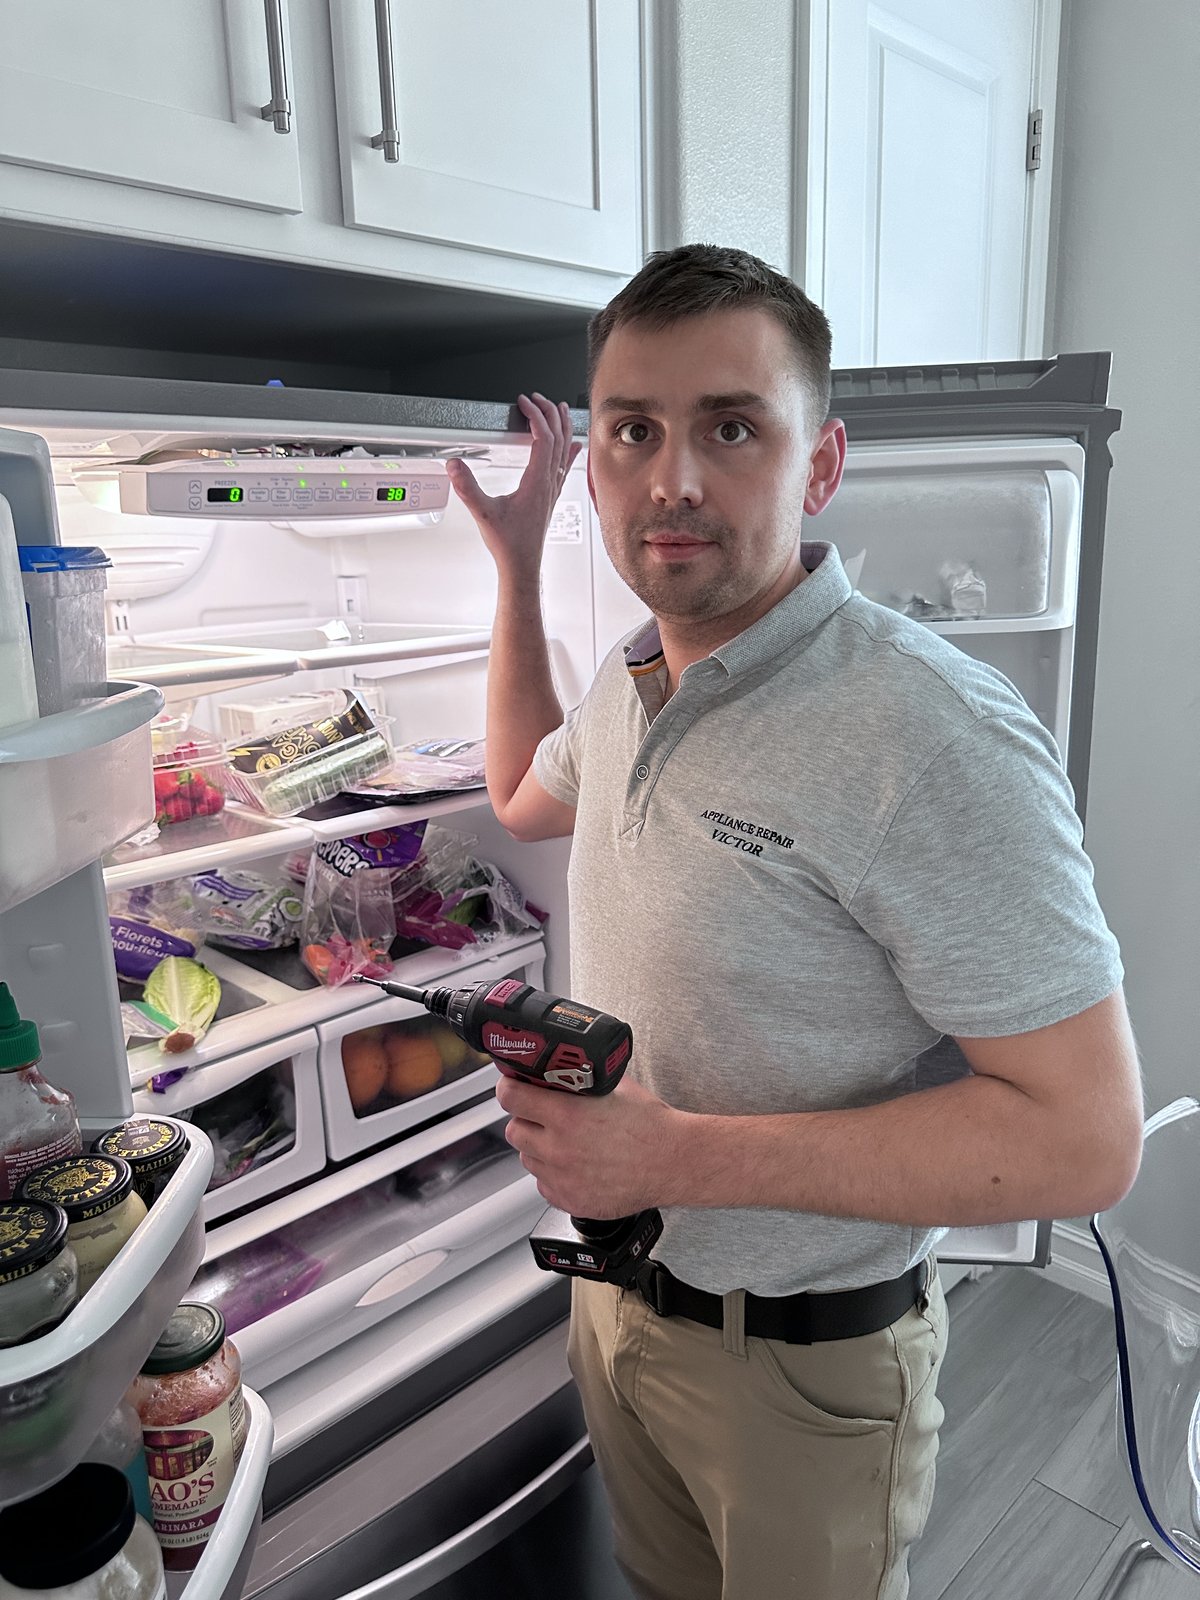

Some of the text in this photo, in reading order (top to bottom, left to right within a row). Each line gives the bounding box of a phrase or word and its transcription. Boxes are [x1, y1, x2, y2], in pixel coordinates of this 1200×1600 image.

[230, 487, 241, 502] 0
[387, 487, 404, 501] 38
[700, 809, 795, 849] APPLIANCE REPAIR
[711, 828, 764, 857] VICTOR
[112, 936, 171, 958] hou-fleur
[116, 926, 164, 948] Florets
[488, 1032, 536, 1050] Milwaukee
[0, 1261, 37, 1284] AILLE
[151, 1471, 215, 1502] AO'S
[152, 1497, 207, 1511] MEMADE
[154, 1519, 205, 1532] ARINARA
